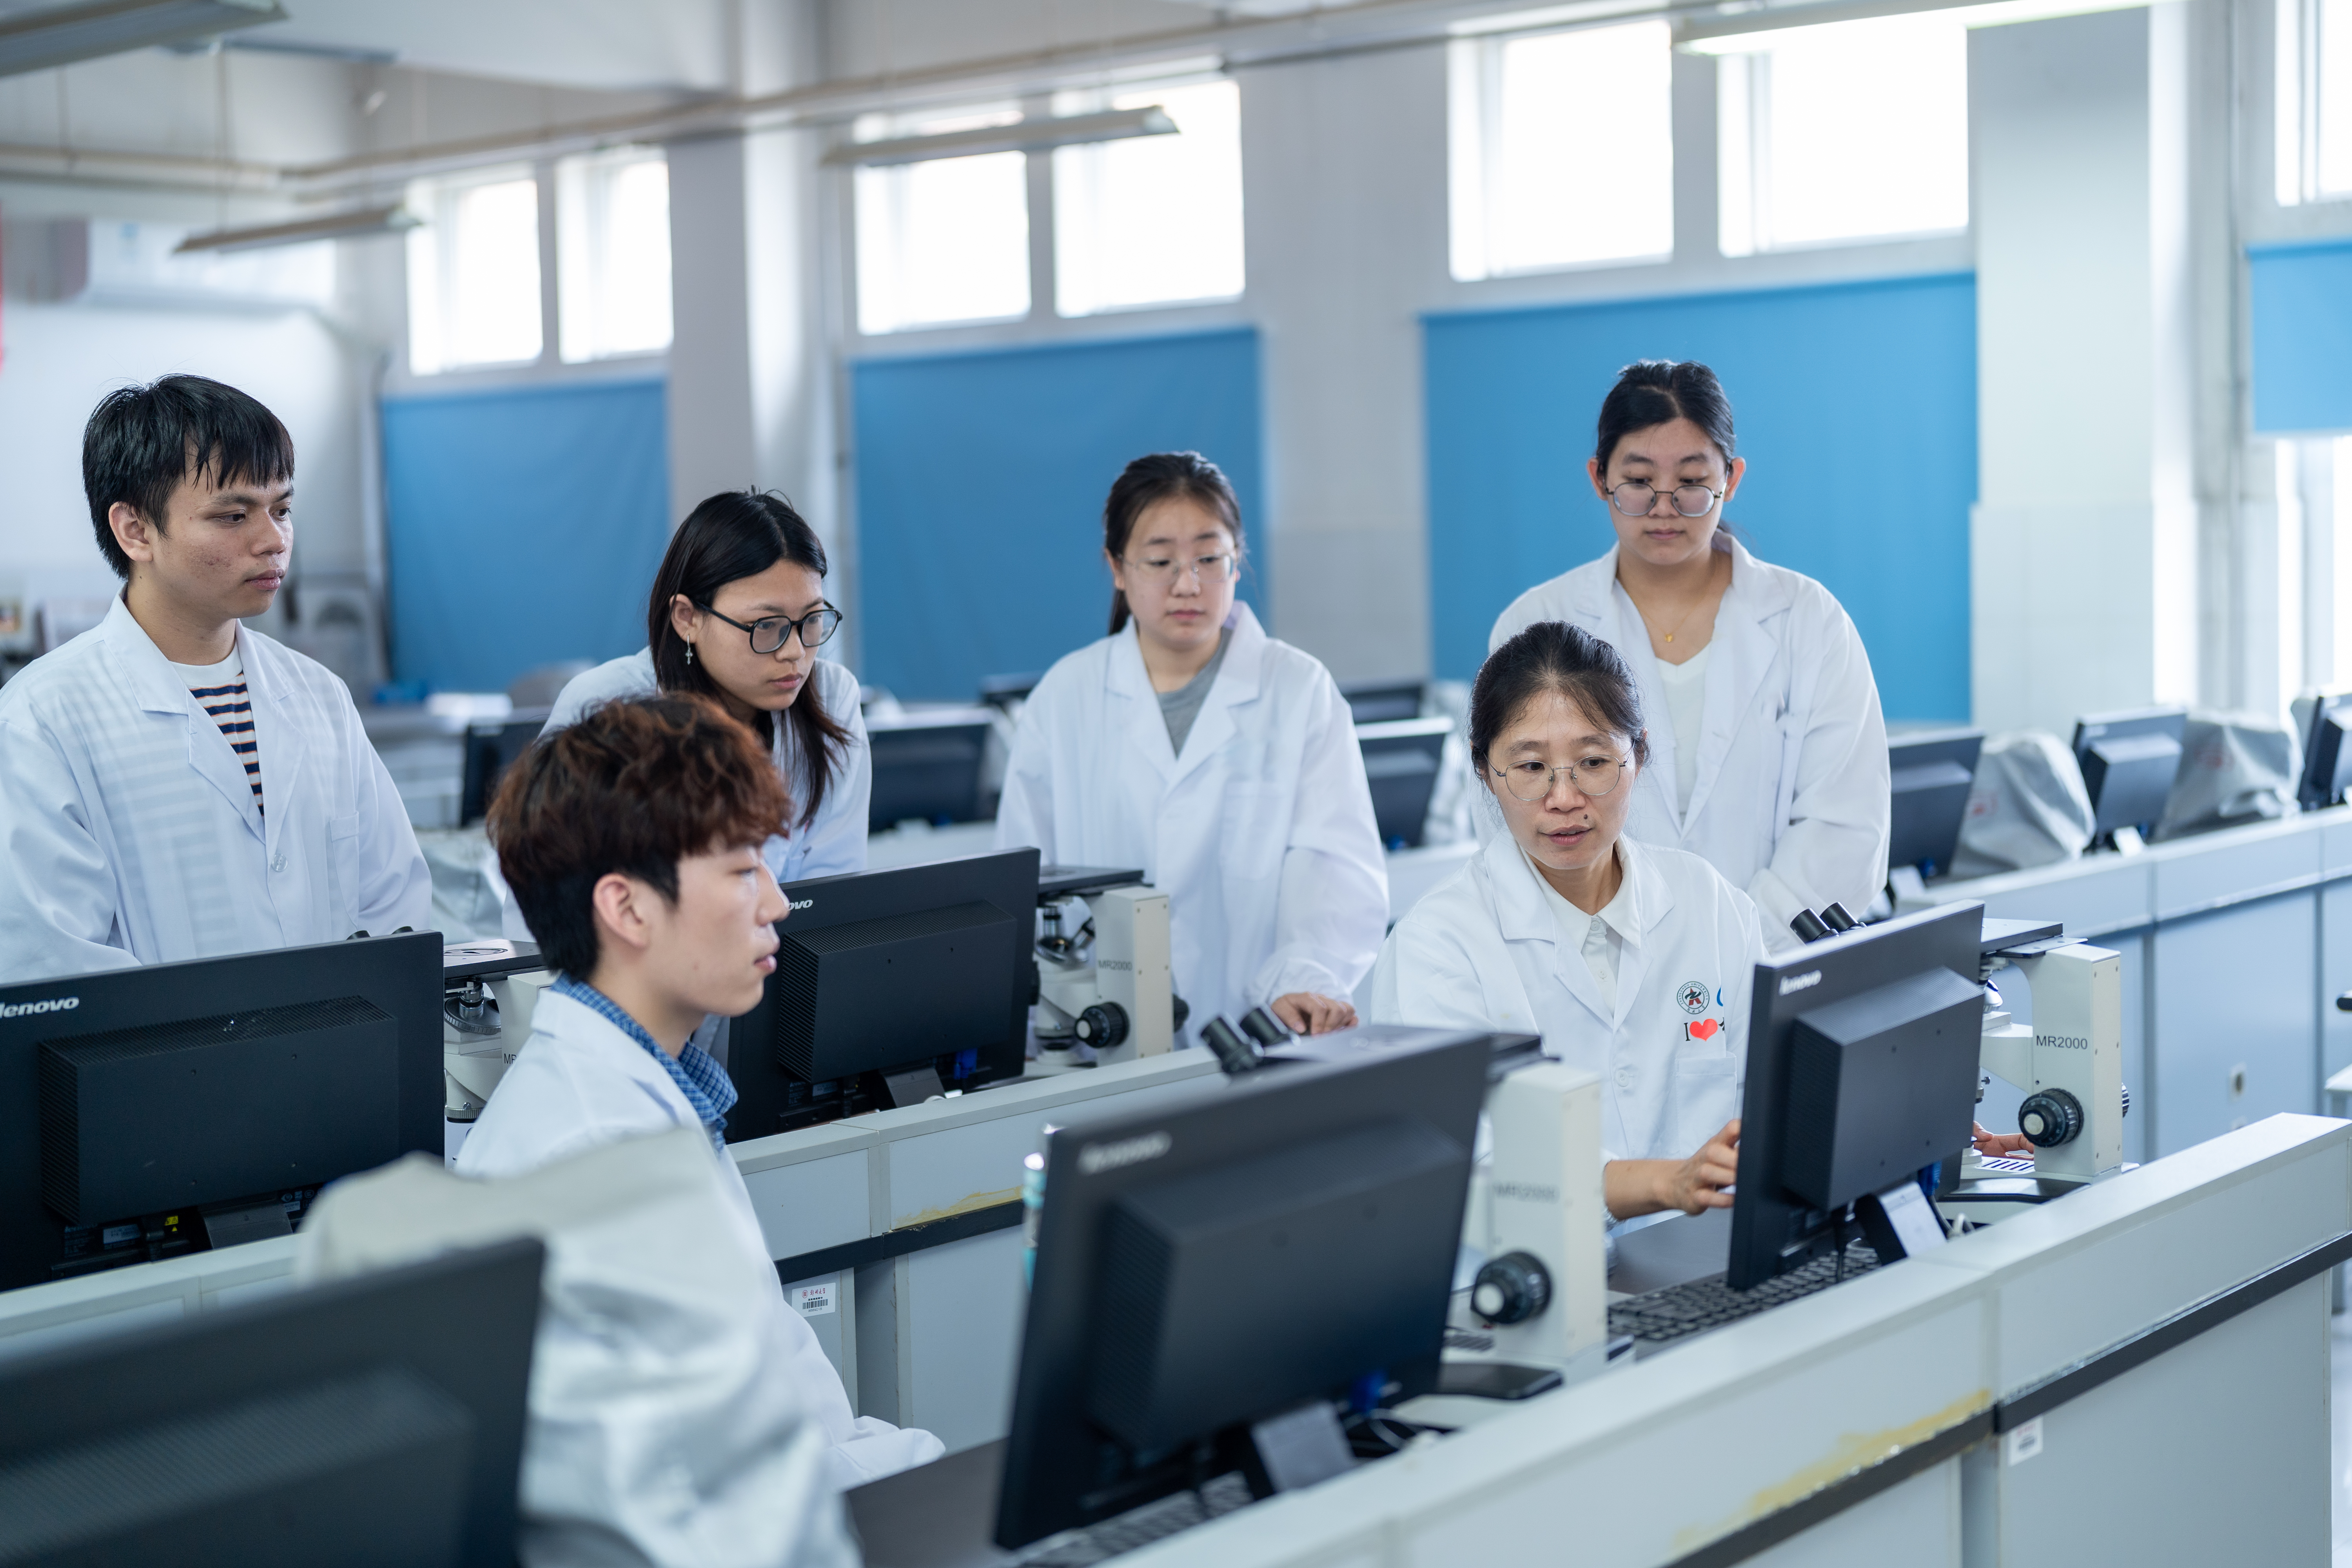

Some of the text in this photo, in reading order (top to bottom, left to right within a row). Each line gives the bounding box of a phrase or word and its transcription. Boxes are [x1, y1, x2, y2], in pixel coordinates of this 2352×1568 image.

[787, 900, 813, 911] ovo
[1684, 1022, 1691, 1041] I
[2036, 1035, 2088, 1049] MR2000
